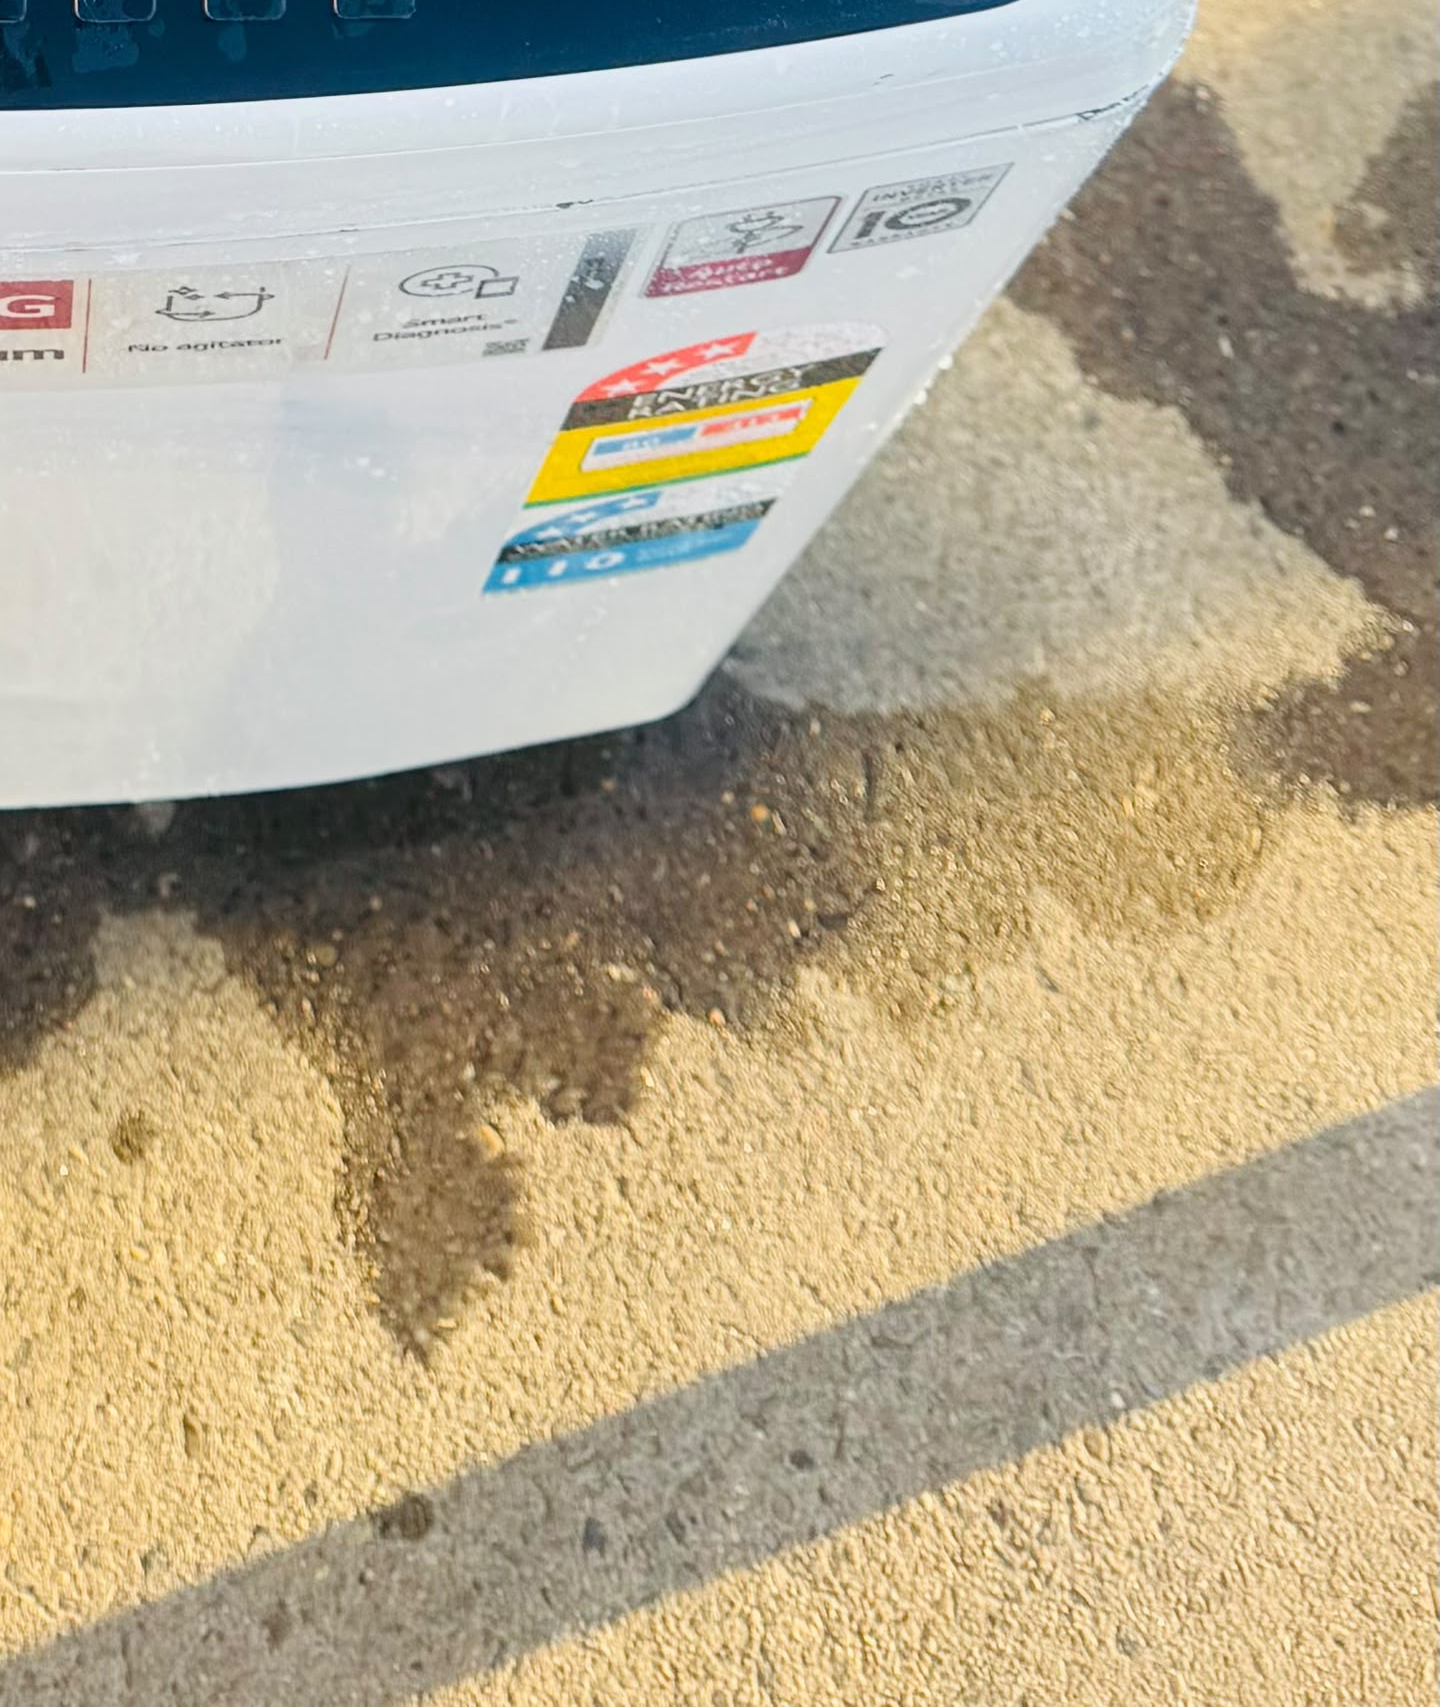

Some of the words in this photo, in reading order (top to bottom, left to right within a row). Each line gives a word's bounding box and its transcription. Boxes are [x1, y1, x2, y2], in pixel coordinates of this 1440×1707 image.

[402, 313, 486, 329] Smart
[128, 340, 170, 353] No
[176, 336, 284, 351] agitator
